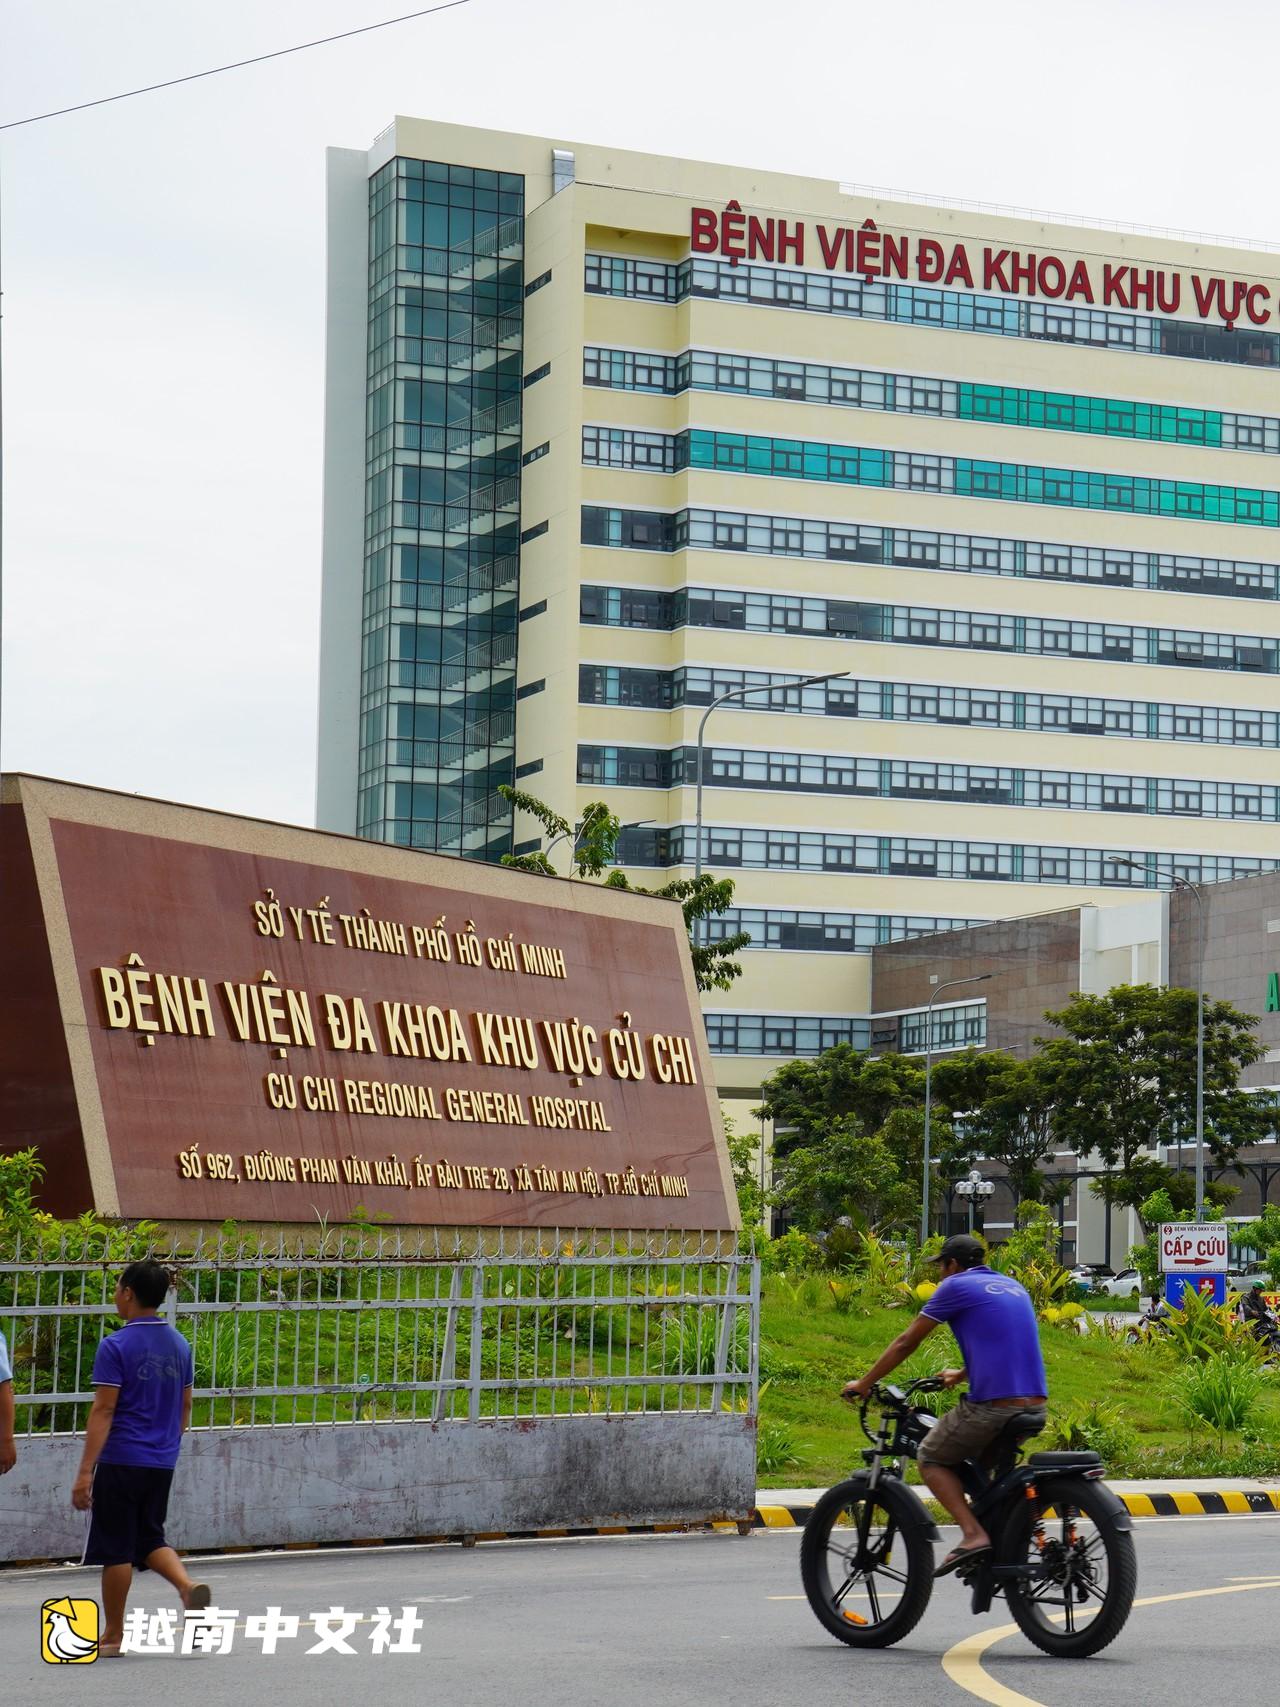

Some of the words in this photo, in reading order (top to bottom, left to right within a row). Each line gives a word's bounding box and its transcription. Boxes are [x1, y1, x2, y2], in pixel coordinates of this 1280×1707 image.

[691, 200, 804, 267] BỆNH
[816, 218, 908, 284] VIỆN
[916, 238, 974, 289] ĐA
[984, 247, 1095, 304] KHOA
[1104, 264, 1181, 314] KHU
[1191, 275, 1271, 331] VỰC
[254, 888, 285, 938] SỞ
[289, 906, 304, 941] Y
[306, 896, 337, 945] TẾ
[339, 908, 409, 955] THÀNH
[412, 915, 451, 962] PHỐ
[456, 919, 482, 967] HỒ
[487, 933, 518, 971] CHÍ
[521, 943, 567, 978] MINH
[100, 953, 216, 1046] BỆNH
[223, 970, 316, 1058] VIỆN
[324, 993, 378, 1053] ĐA
[383, 1001, 472, 1062] KHOA
[476, 1012, 539, 1070] KHU
[543, 1017, 603, 1087] VỰC
[609, 1011, 646, 1081] CỦ
[652, 1033, 698, 1085] CHI
[1264, 971, 1280, 1013] A
[267, 1072, 297, 1109] CU
[302, 1075, 340, 1112] CHI
[344, 1079, 442, 1119] REGIONAL
[446, 1087, 529, 1126] GENERAL
[533, 1095, 612, 1132] HOSPITAL
[180, 1142, 202, 1179] SỐ
[206, 1153, 240, 1183] 962,
[244, 1149, 297, 1182] ĐƯỜNG
[301, 1157, 339, 1183] PHAN
[342, 1154, 372, 1185] VĂN
[375, 1153, 413, 1190] KHẢI,
[415, 1154, 433, 1187] ẤP
[436, 1159, 463, 1188] BÀU
[464, 1166, 491, 1190] TRE
[492, 1167, 514, 1194] 2B,
[515, 1163, 534, 1191] XÃ
[534, 1164, 560, 1192] TÂN
[562, 1170, 578, 1193] AN
[580, 1166, 604, 1198] HỘI,
[640, 1169, 660, 1197] CHÍ
[661, 1175, 689, 1198] MINH
[1164, 1234, 1193, 1257] CẤP
[1196, 1236, 1225, 1257] CỨU
